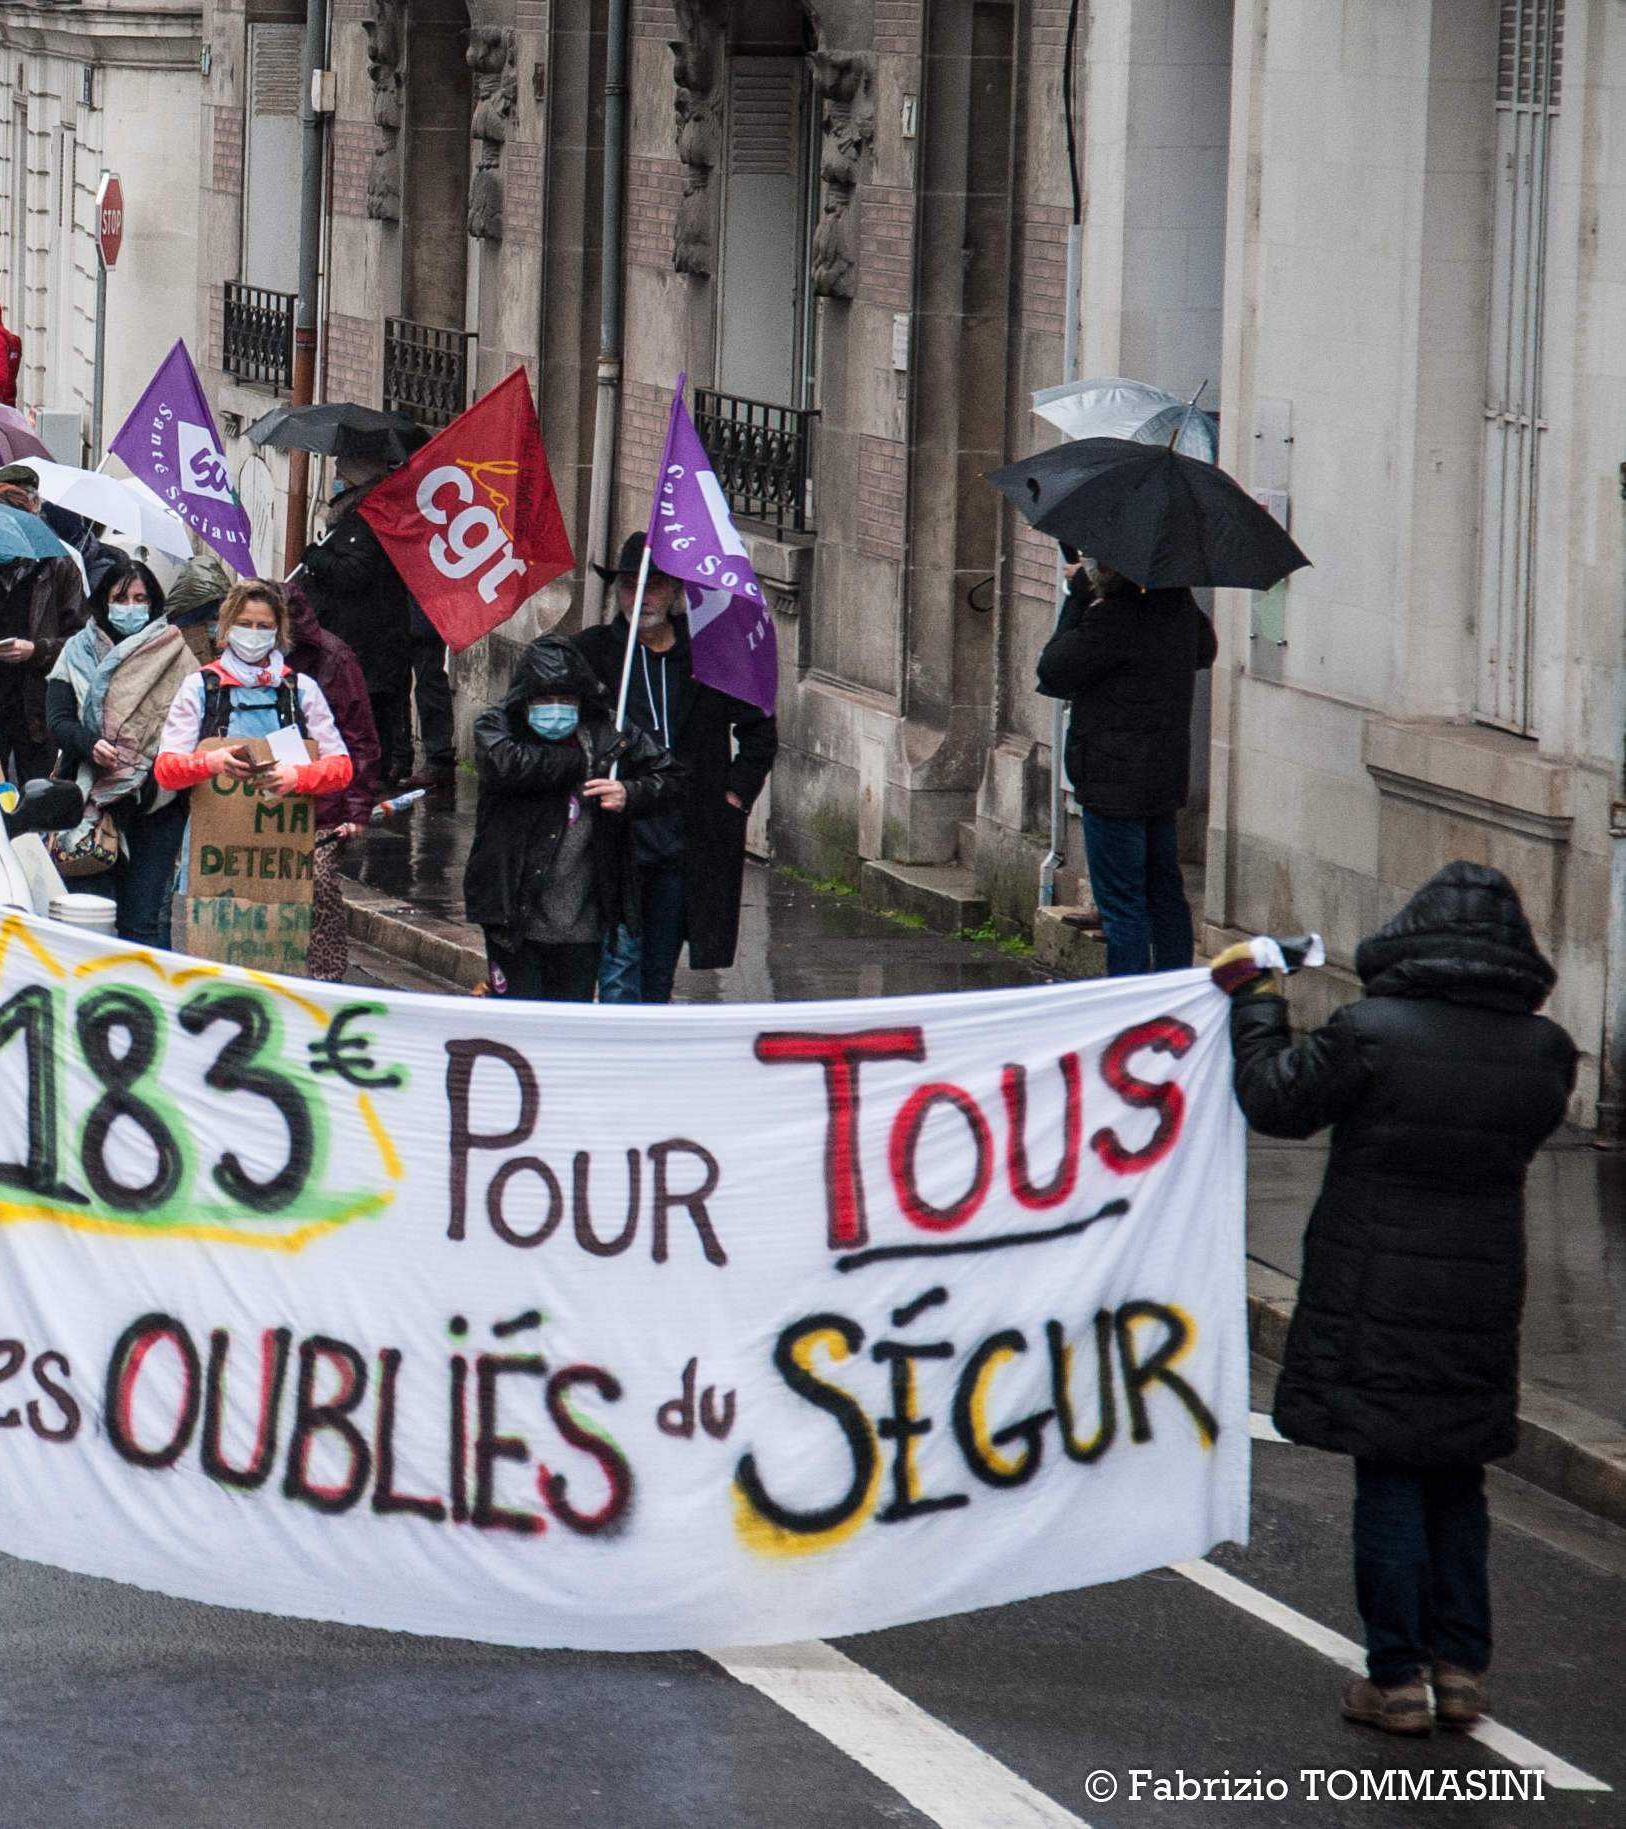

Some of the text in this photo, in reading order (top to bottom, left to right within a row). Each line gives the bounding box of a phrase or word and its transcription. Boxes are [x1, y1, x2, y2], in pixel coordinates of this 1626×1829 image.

[102, 209, 122, 236] STOP
[150, 402, 173, 475] Santé
[254, 801, 310, 834] MA
[753, 1015, 1198, 1250] TOUS
[657, 1357, 737, 1440] du
